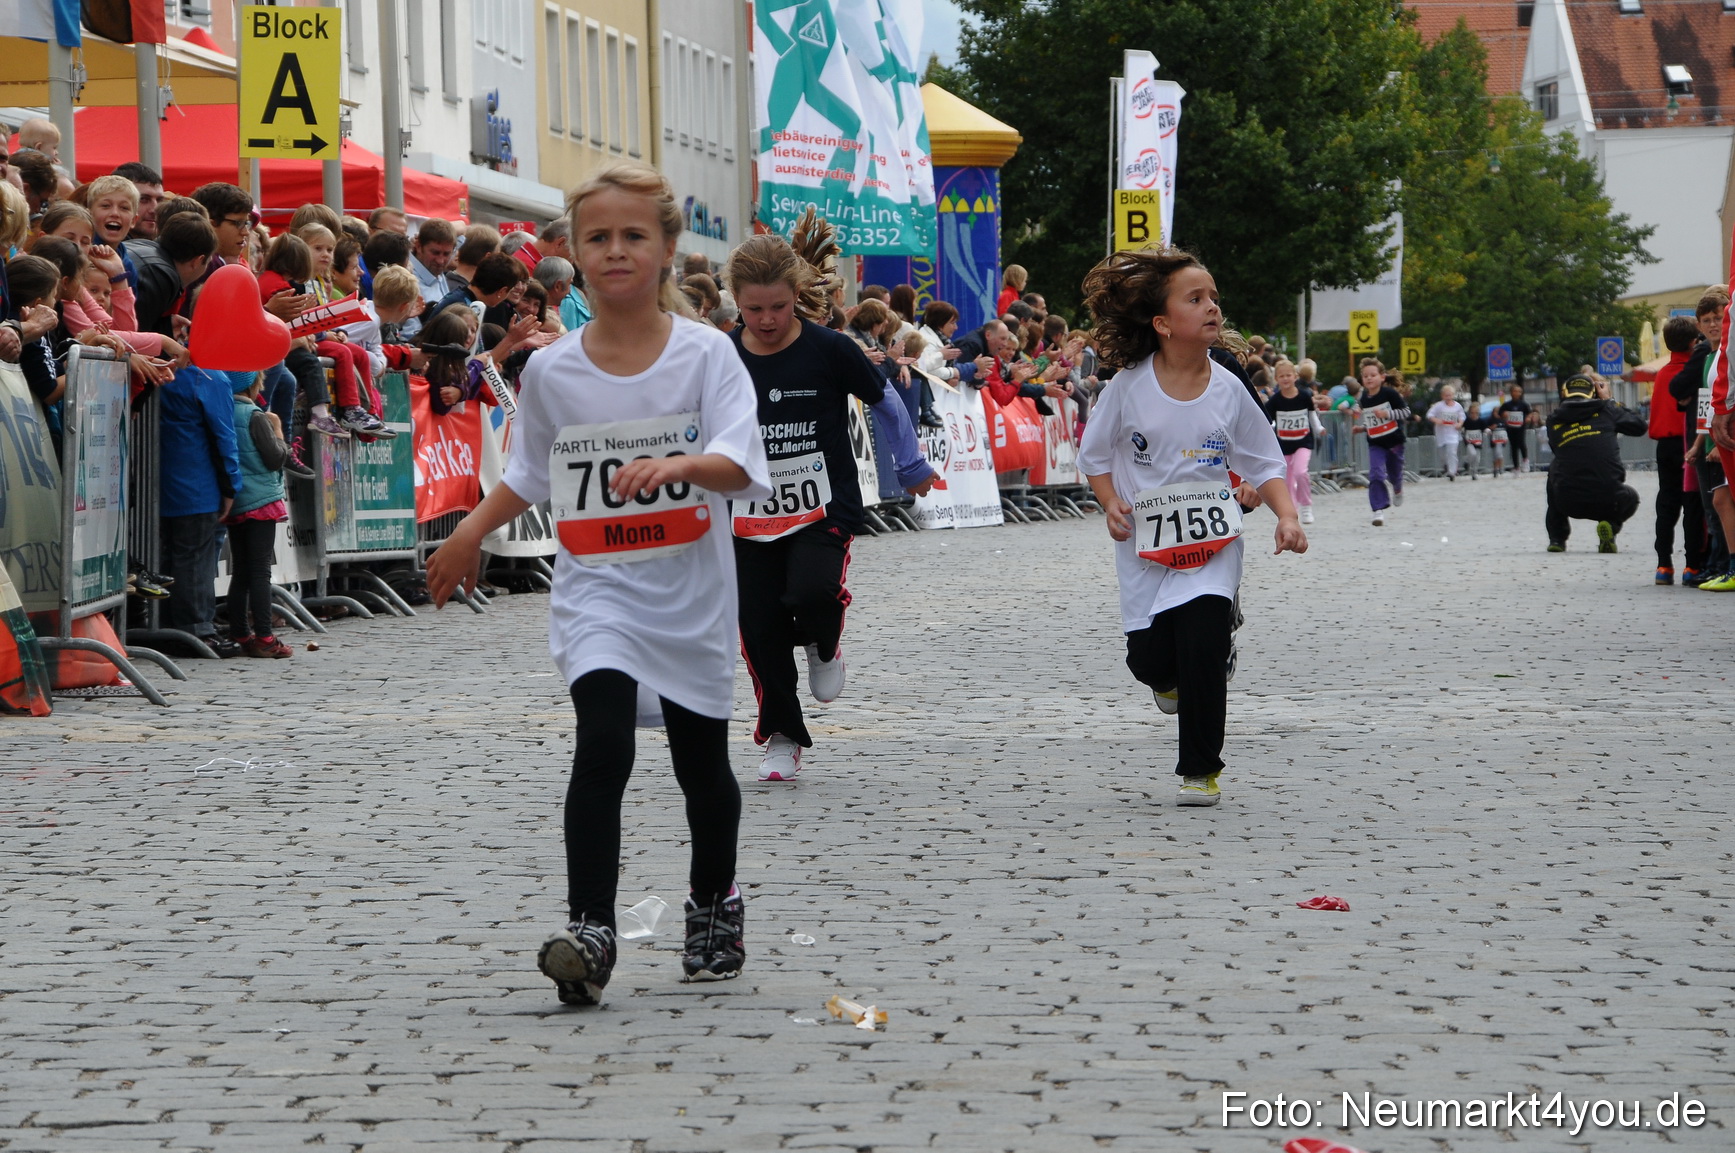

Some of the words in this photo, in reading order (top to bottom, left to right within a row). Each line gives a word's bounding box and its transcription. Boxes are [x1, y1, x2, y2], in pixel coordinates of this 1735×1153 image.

[253, 11, 329, 39] Block
[260, 52, 318, 125] A
[1120, 192, 1155, 204] Block
[1127, 210, 1149, 242] B
[1356, 323, 1371, 343] C
[1407, 349, 1419, 365] D
[1490, 369, 1512, 377] TAXI
[1600, 363, 1622, 373] TAXI
[1281, 417, 1305, 430] 7247
[553, 440, 601, 455] PARTL
[605, 432, 679, 451] Neumarkt
[1134, 497, 1167, 511] PARTL
[1168, 491, 1216, 504] Neumarkt
[559, 508, 566, 518] 3
[604, 523, 666, 547] Mona
[1146, 506, 1230, 548] 7158
